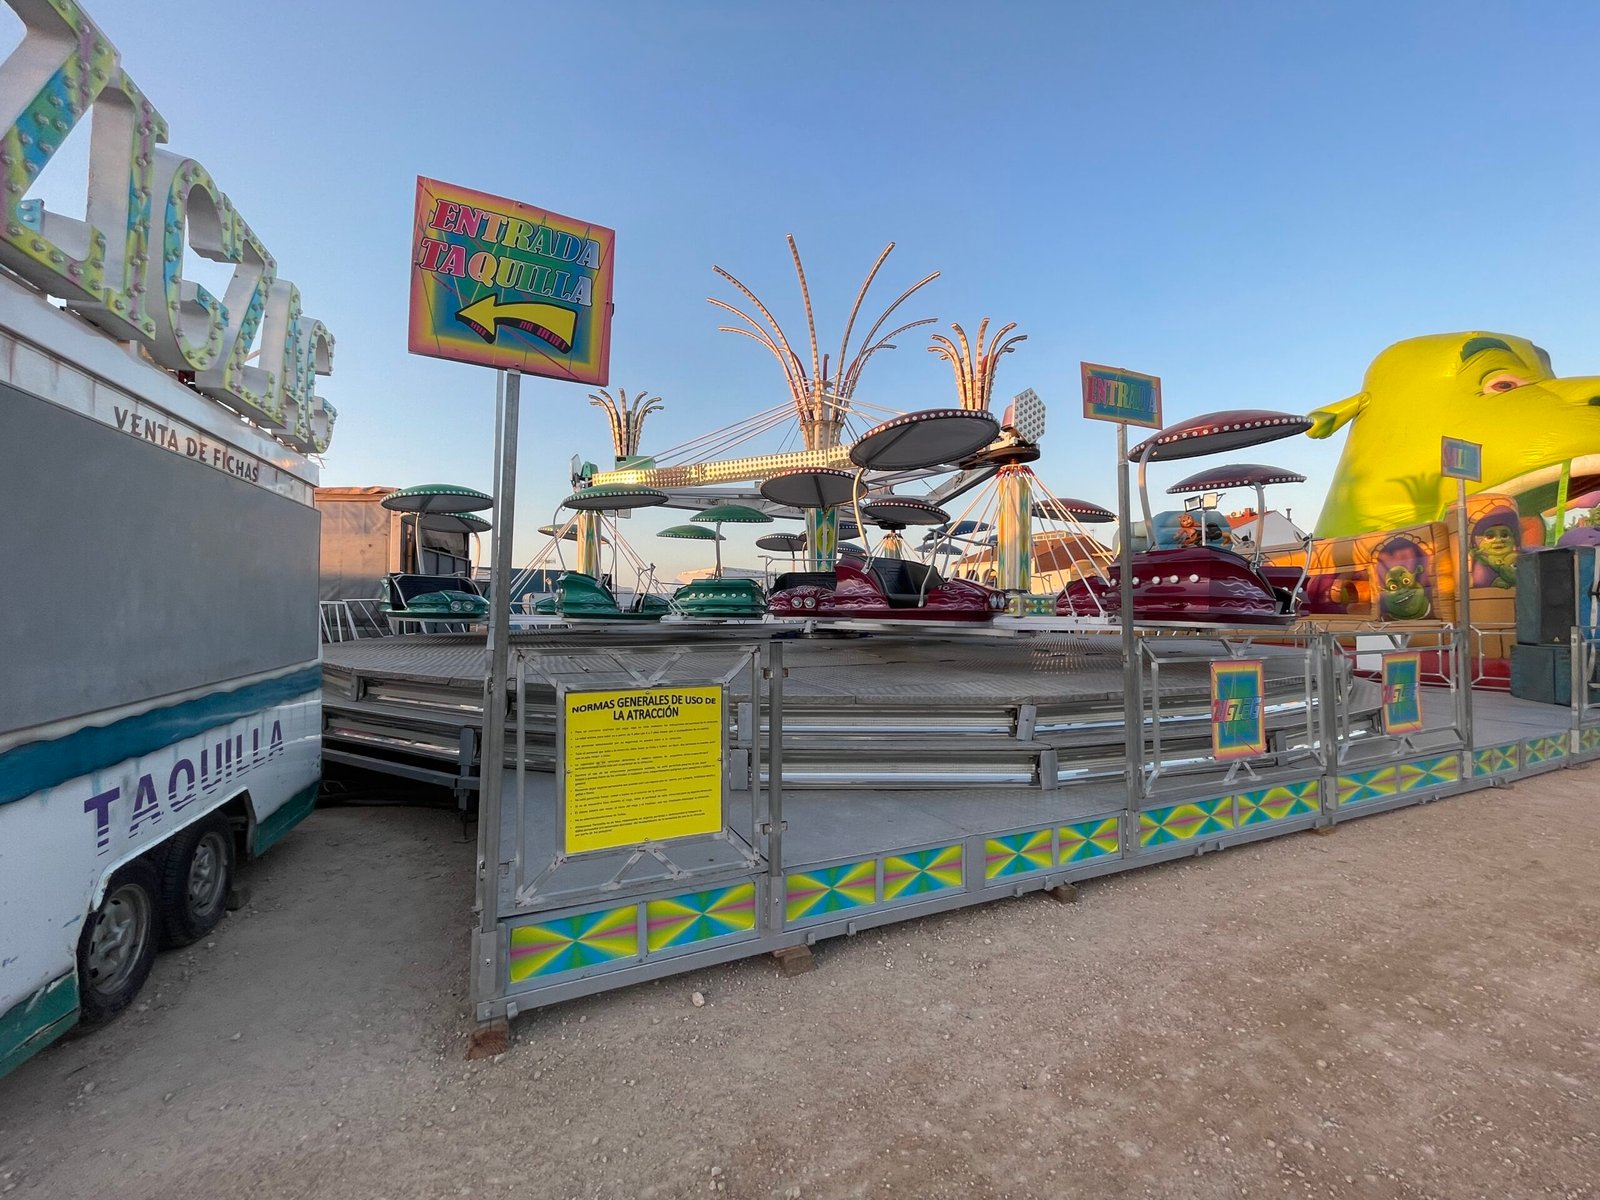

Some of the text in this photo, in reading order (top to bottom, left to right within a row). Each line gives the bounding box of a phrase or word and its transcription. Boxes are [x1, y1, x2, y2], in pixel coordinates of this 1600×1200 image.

[430, 198, 602, 270] ENTRADA
[419, 238, 593, 307] TAQUILLA
[1086, 376, 1158, 414] ENTRADA
[113, 406, 259, 483] VENTA DE FICHAS
[572, 694, 717, 713] NORMAS GENERALES DE USO DE
[613, 705, 679, 721] LA ATRACCIÓN
[83, 720, 285, 856] TAQUILLA
